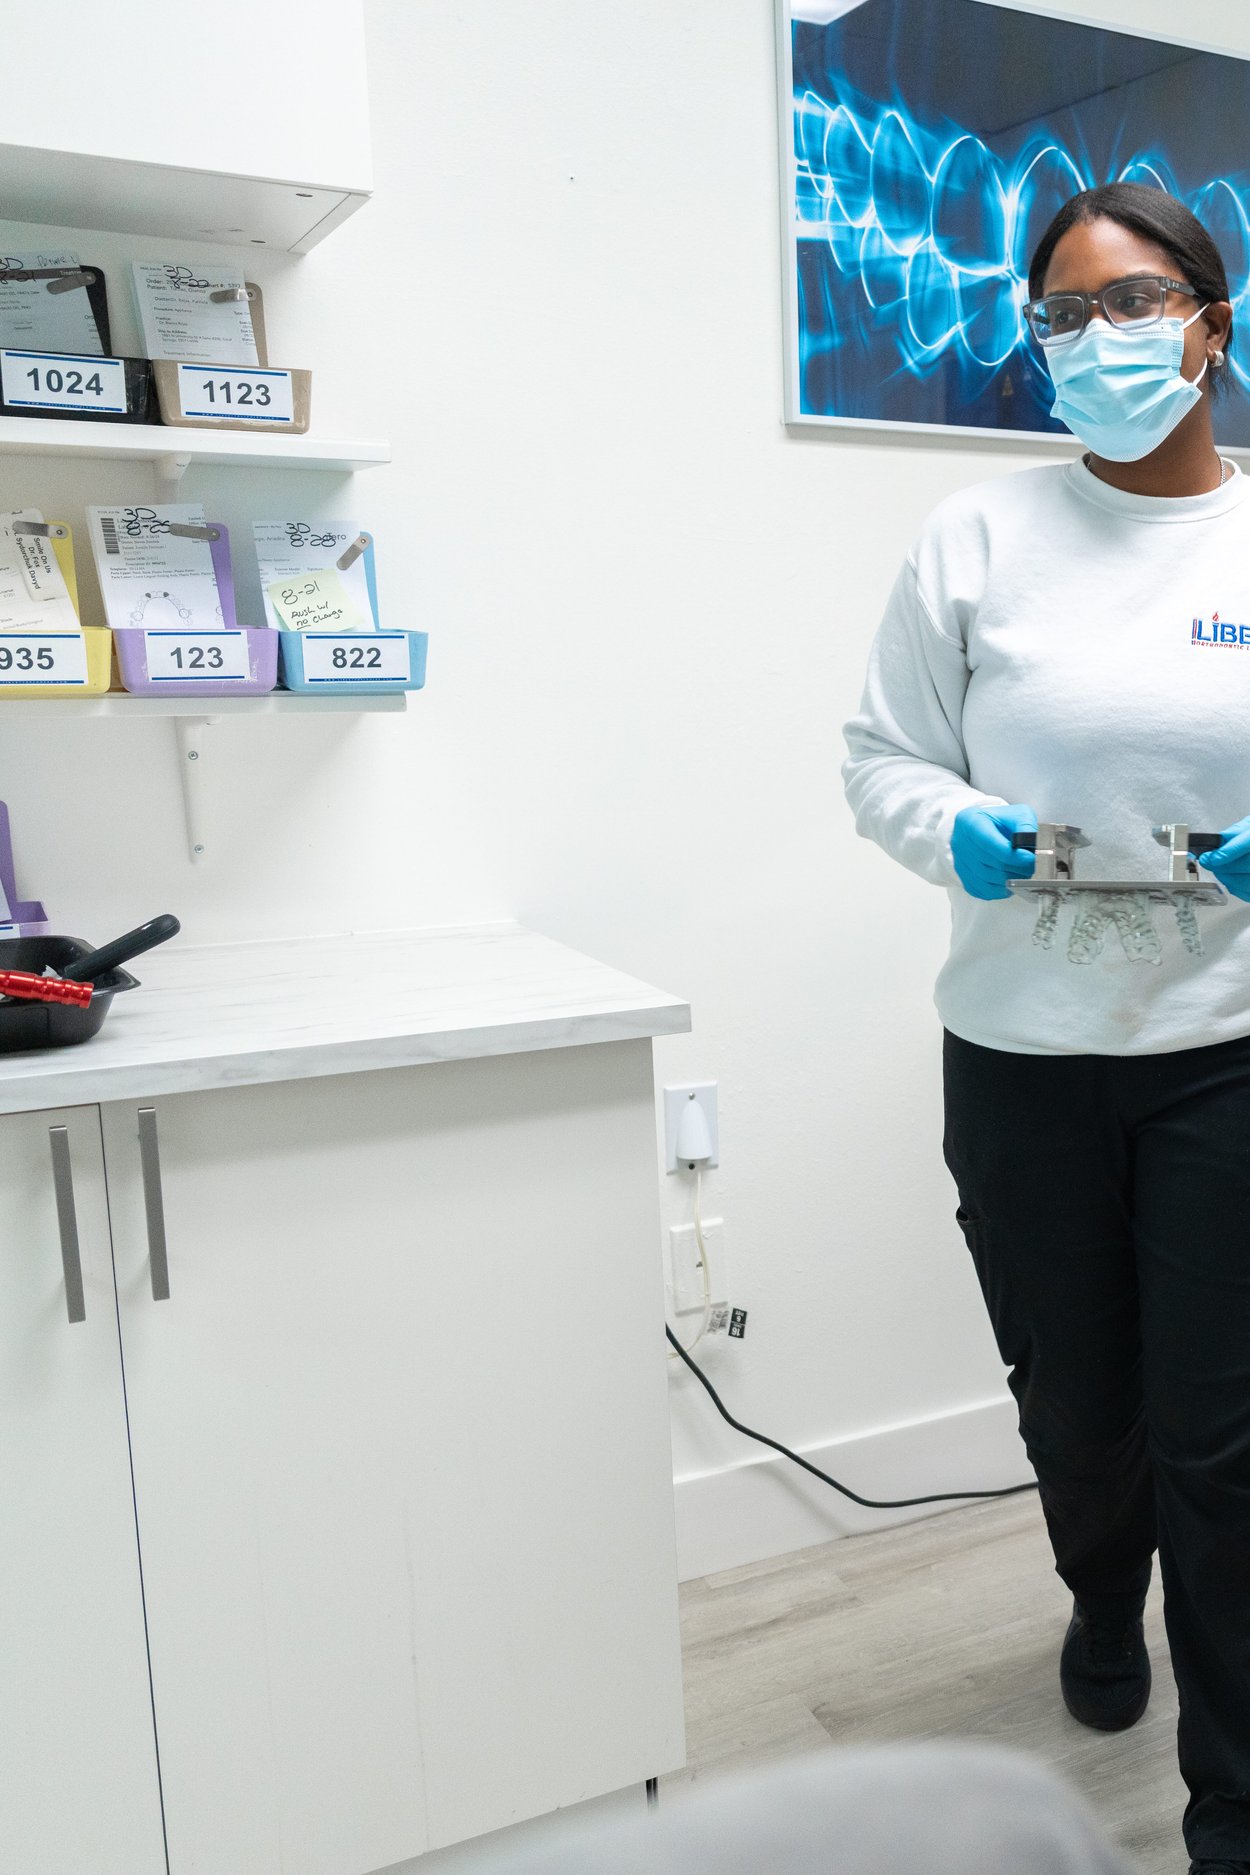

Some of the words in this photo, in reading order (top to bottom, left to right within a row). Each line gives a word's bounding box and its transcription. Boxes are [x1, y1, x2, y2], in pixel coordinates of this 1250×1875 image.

[163, 264, 193, 279] 3D
[26, 367, 104, 396] 1024
[202, 380, 271, 406] 1123
[121, 507, 157, 523] 3D
[285, 522, 311, 535] 3D
[290, 533, 336, 548] 8-28
[32, 556, 41, 568] Fox
[33, 537, 44, 555] Smile
[40, 555, 48, 565] On
[44, 565, 52, 574] Us
[281, 577, 320, 606] 8-21
[0, 647, 55, 670] 935
[170, 646, 224, 669] 123
[332, 647, 382, 669] 822
